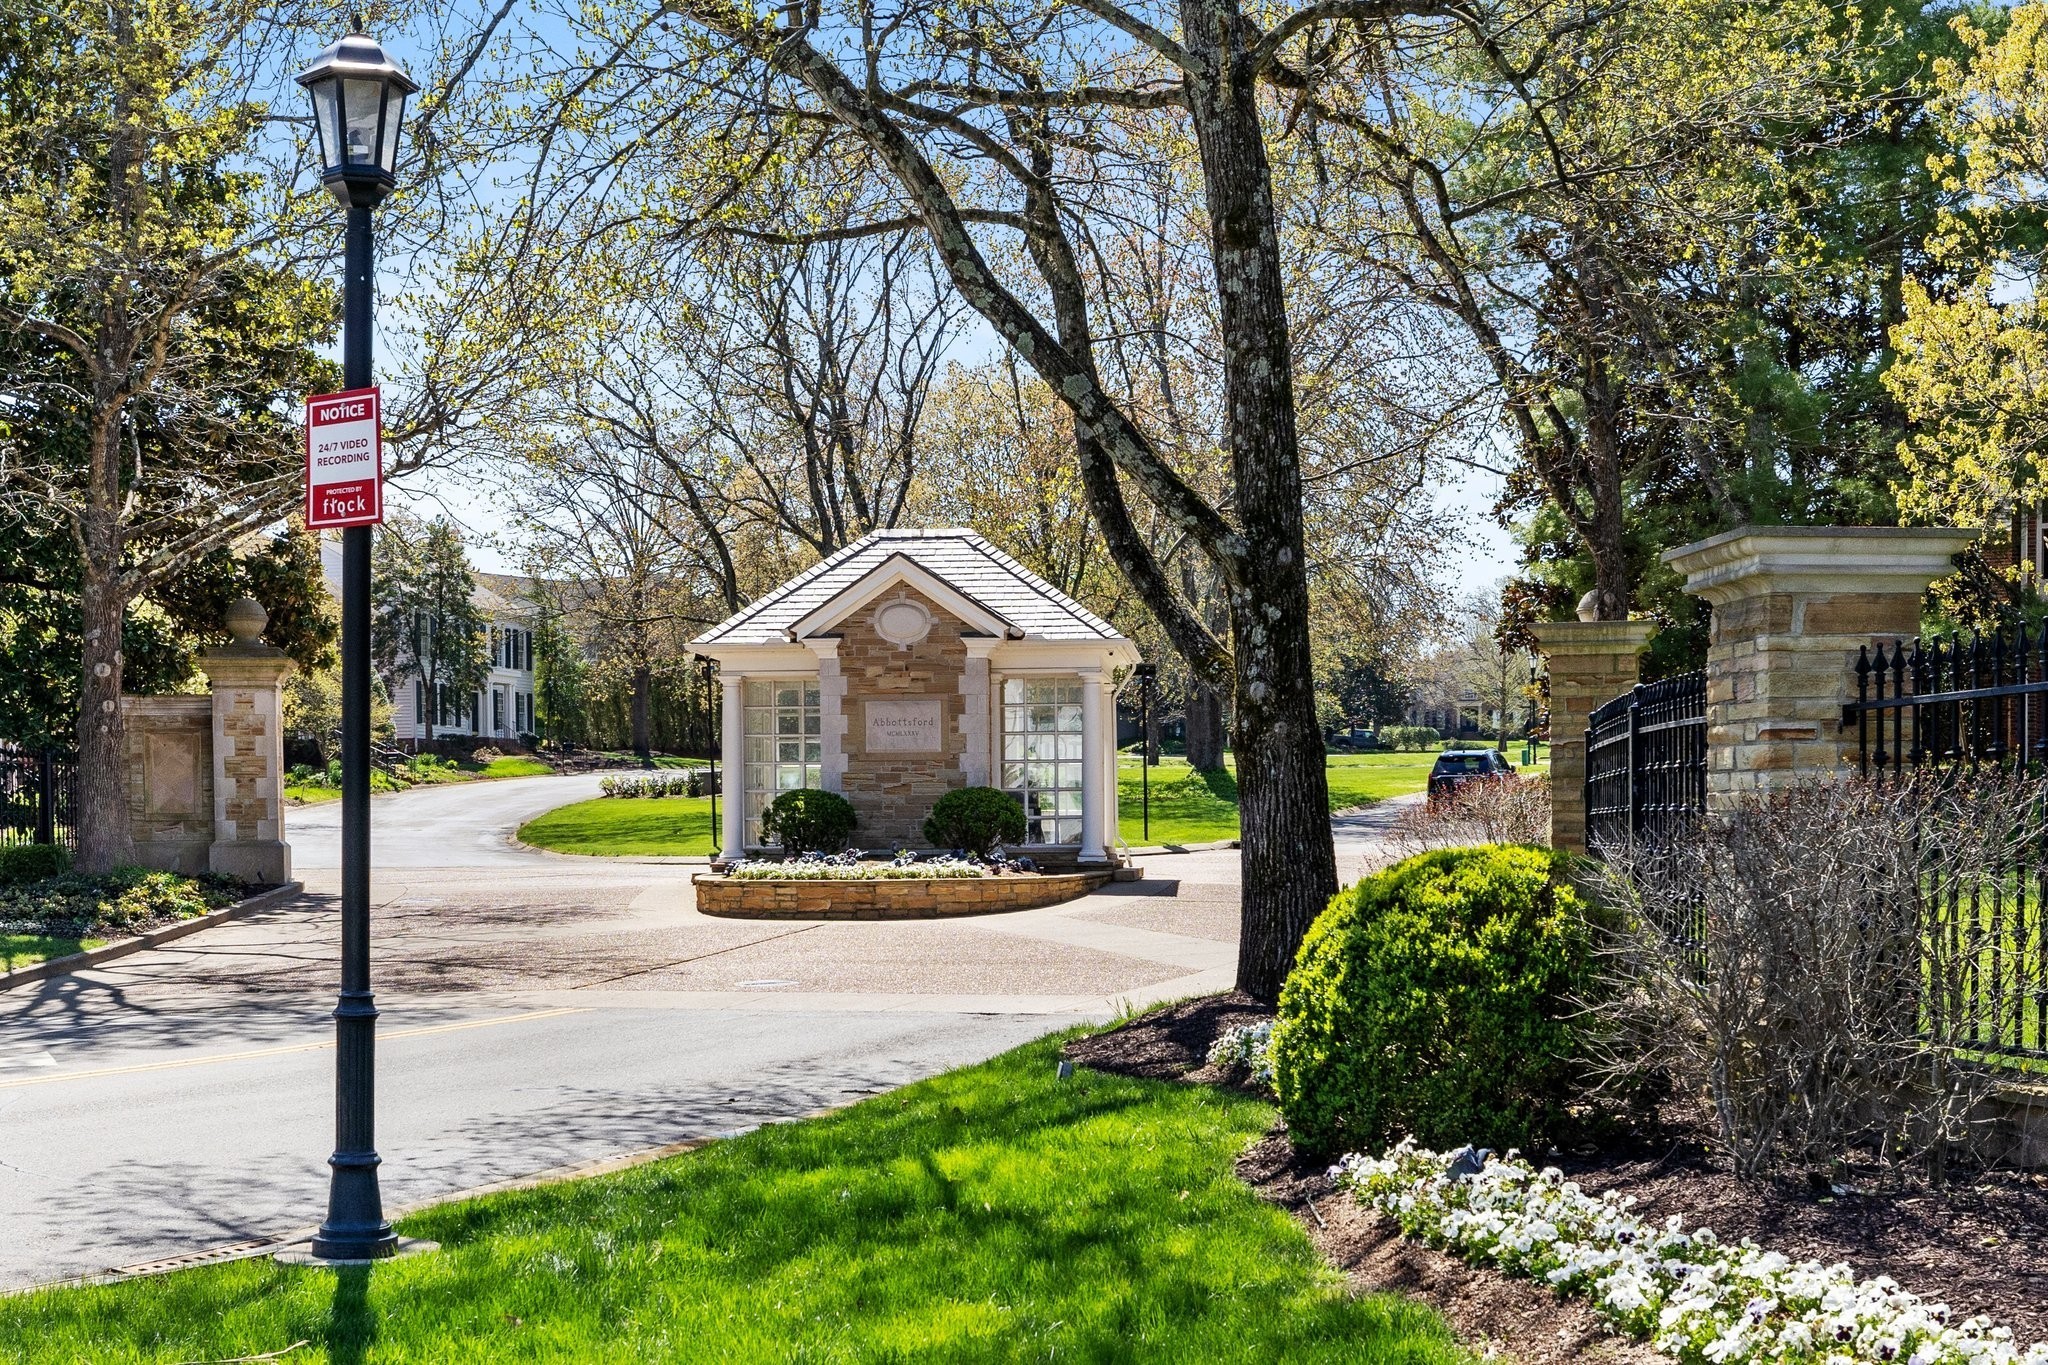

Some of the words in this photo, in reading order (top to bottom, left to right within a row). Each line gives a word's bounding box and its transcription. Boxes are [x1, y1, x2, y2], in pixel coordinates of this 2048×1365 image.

[320, 403, 365, 421] NOTICE
[318, 442, 338, 453] 24/7
[340, 438, 368, 450] VIDEO
[317, 452, 370, 466] RECORDING
[326, 487, 355, 495] PROTECTED
[873, 717, 934, 726] Abbottsford
